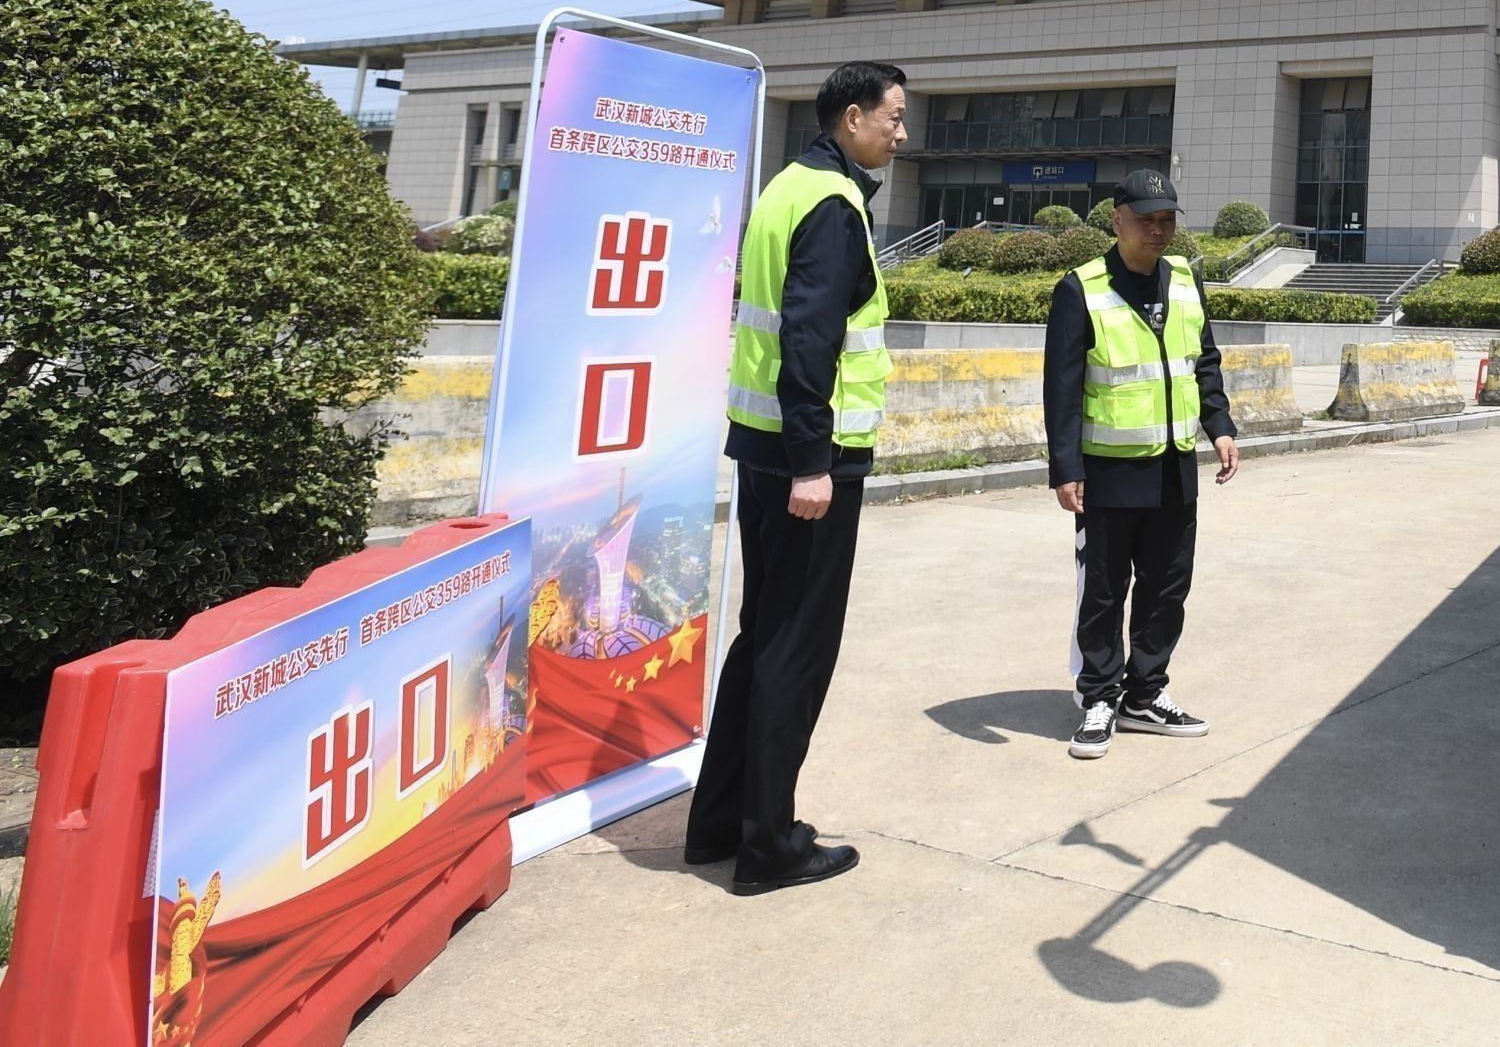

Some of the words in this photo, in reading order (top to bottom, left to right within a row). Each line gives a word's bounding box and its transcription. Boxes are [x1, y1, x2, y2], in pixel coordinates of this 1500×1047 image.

[549, 127, 736, 172] 首条跨区公交359路开通仪式
[594, 97, 706, 136] 武汉新城公交先行
[576, 216, 670, 458] 出口
[214, 627, 349, 719] 武汉新城公交先行
[359, 551, 511, 647] 首条跨区公交359路开通仪式
[304, 657, 451, 866] 出口
